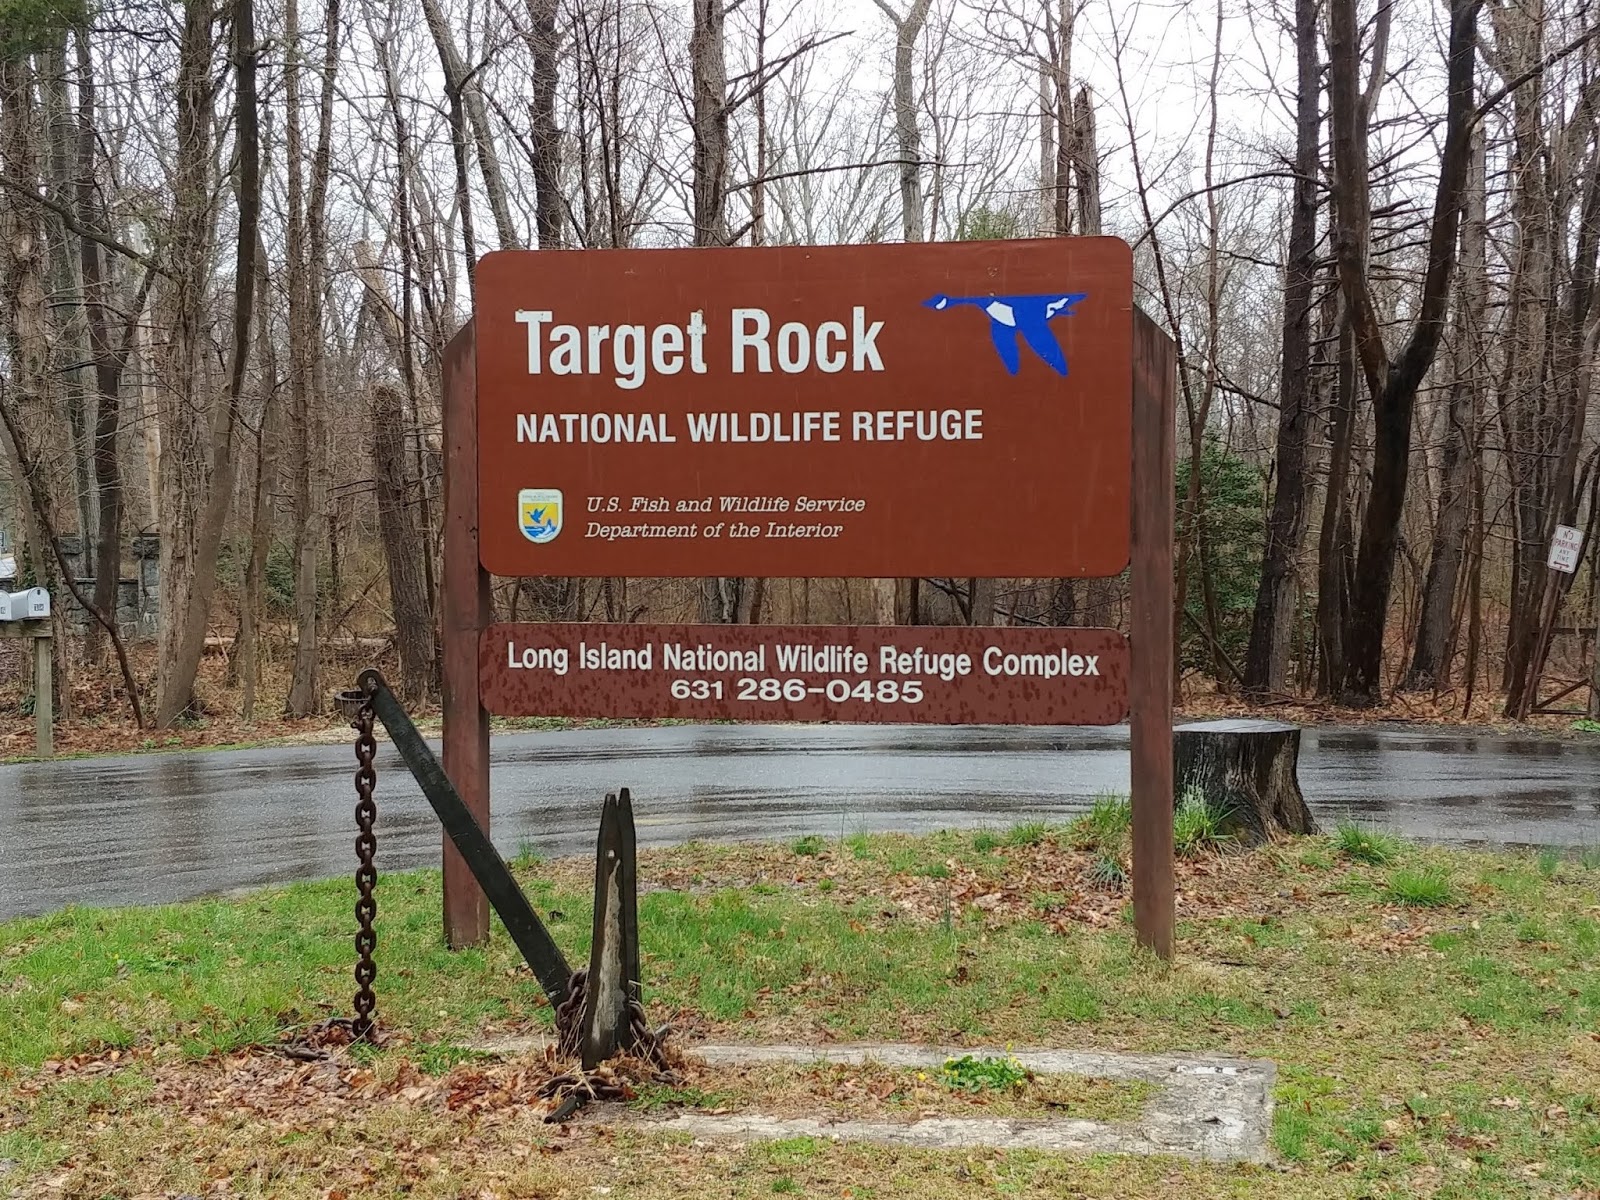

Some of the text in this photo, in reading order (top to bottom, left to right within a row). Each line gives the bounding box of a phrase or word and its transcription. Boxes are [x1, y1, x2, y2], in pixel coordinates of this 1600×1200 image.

[514, 306, 885, 389] Target Rock
[516, 409, 983, 443] NATIONAL WILDLIFE REFUGE
[586, 495, 866, 513] U.S. Fish and Wildlife Service
[584, 522, 843, 541] Department of the Interior
[1563, 531, 1574, 540] NO
[508, 641, 1100, 679] Long Island National Wildlife Refuge Complex
[670, 677, 924, 703] 631 286-0485
